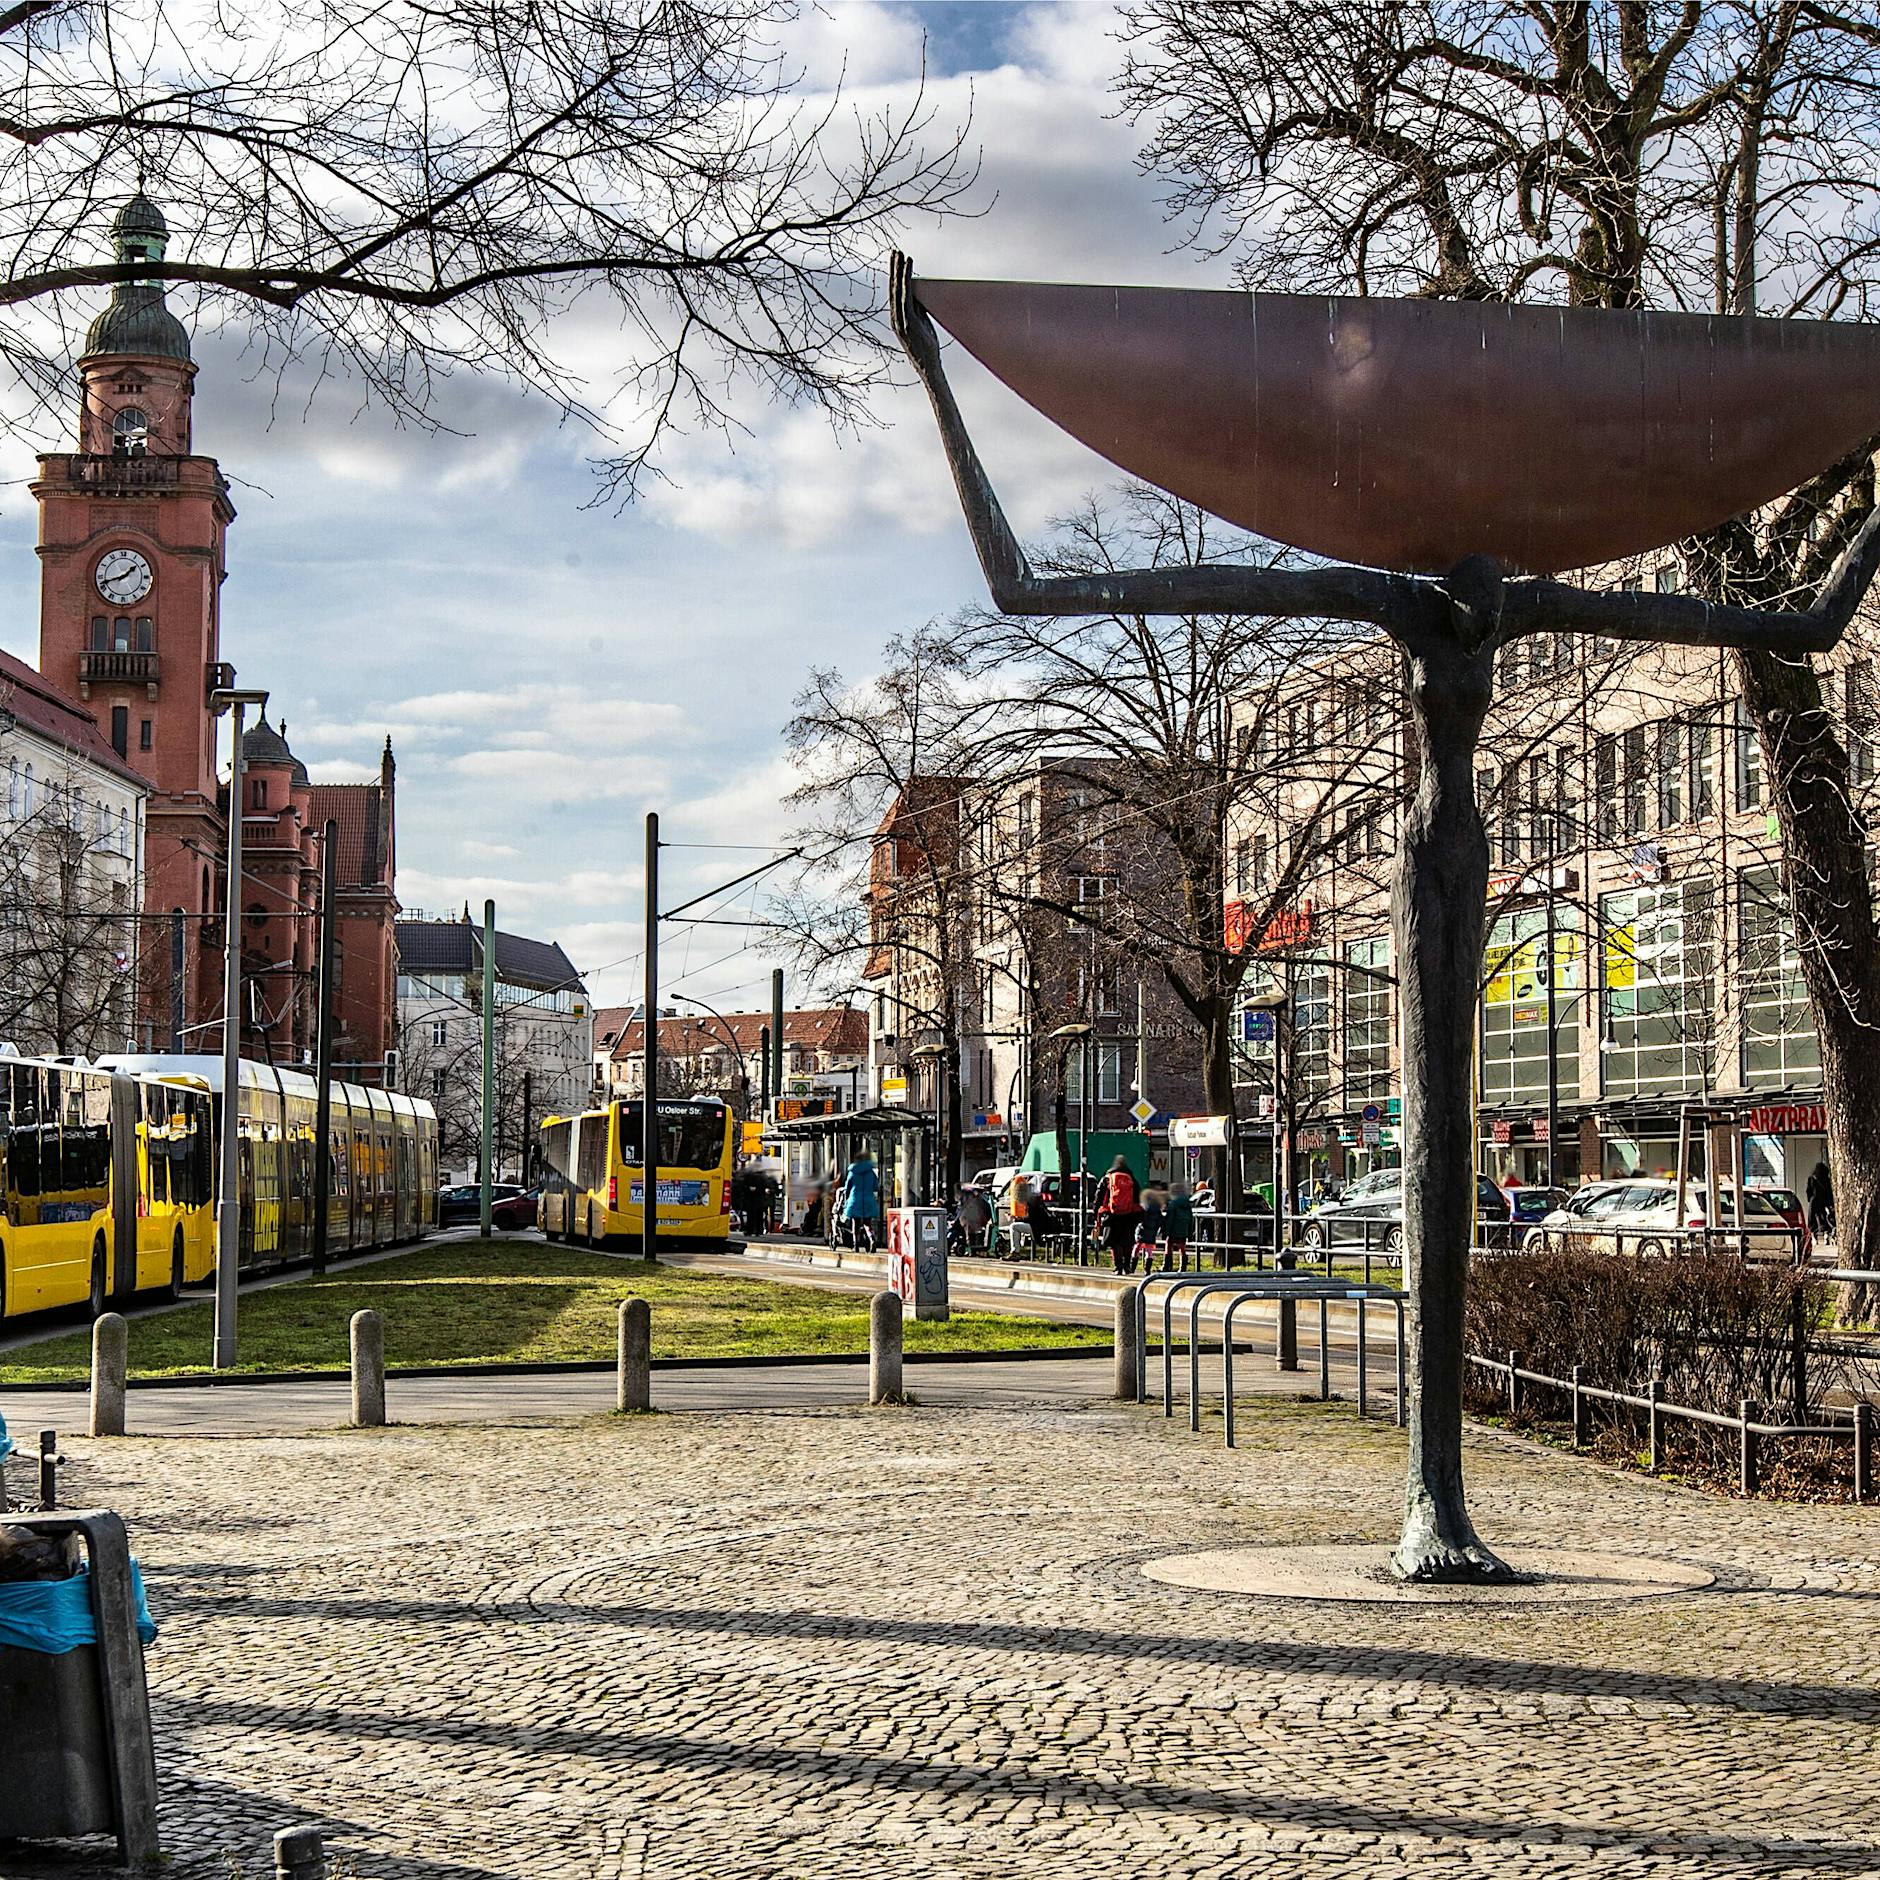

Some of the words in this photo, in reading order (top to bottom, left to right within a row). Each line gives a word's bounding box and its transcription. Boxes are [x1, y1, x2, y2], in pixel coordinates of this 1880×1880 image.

[657, 1106, 664, 1114] U
[665, 1106, 688, 1115] Osloer
[689, 1107, 702, 1115] Str.
[1533, 1119, 1549, 1131] BLUM
